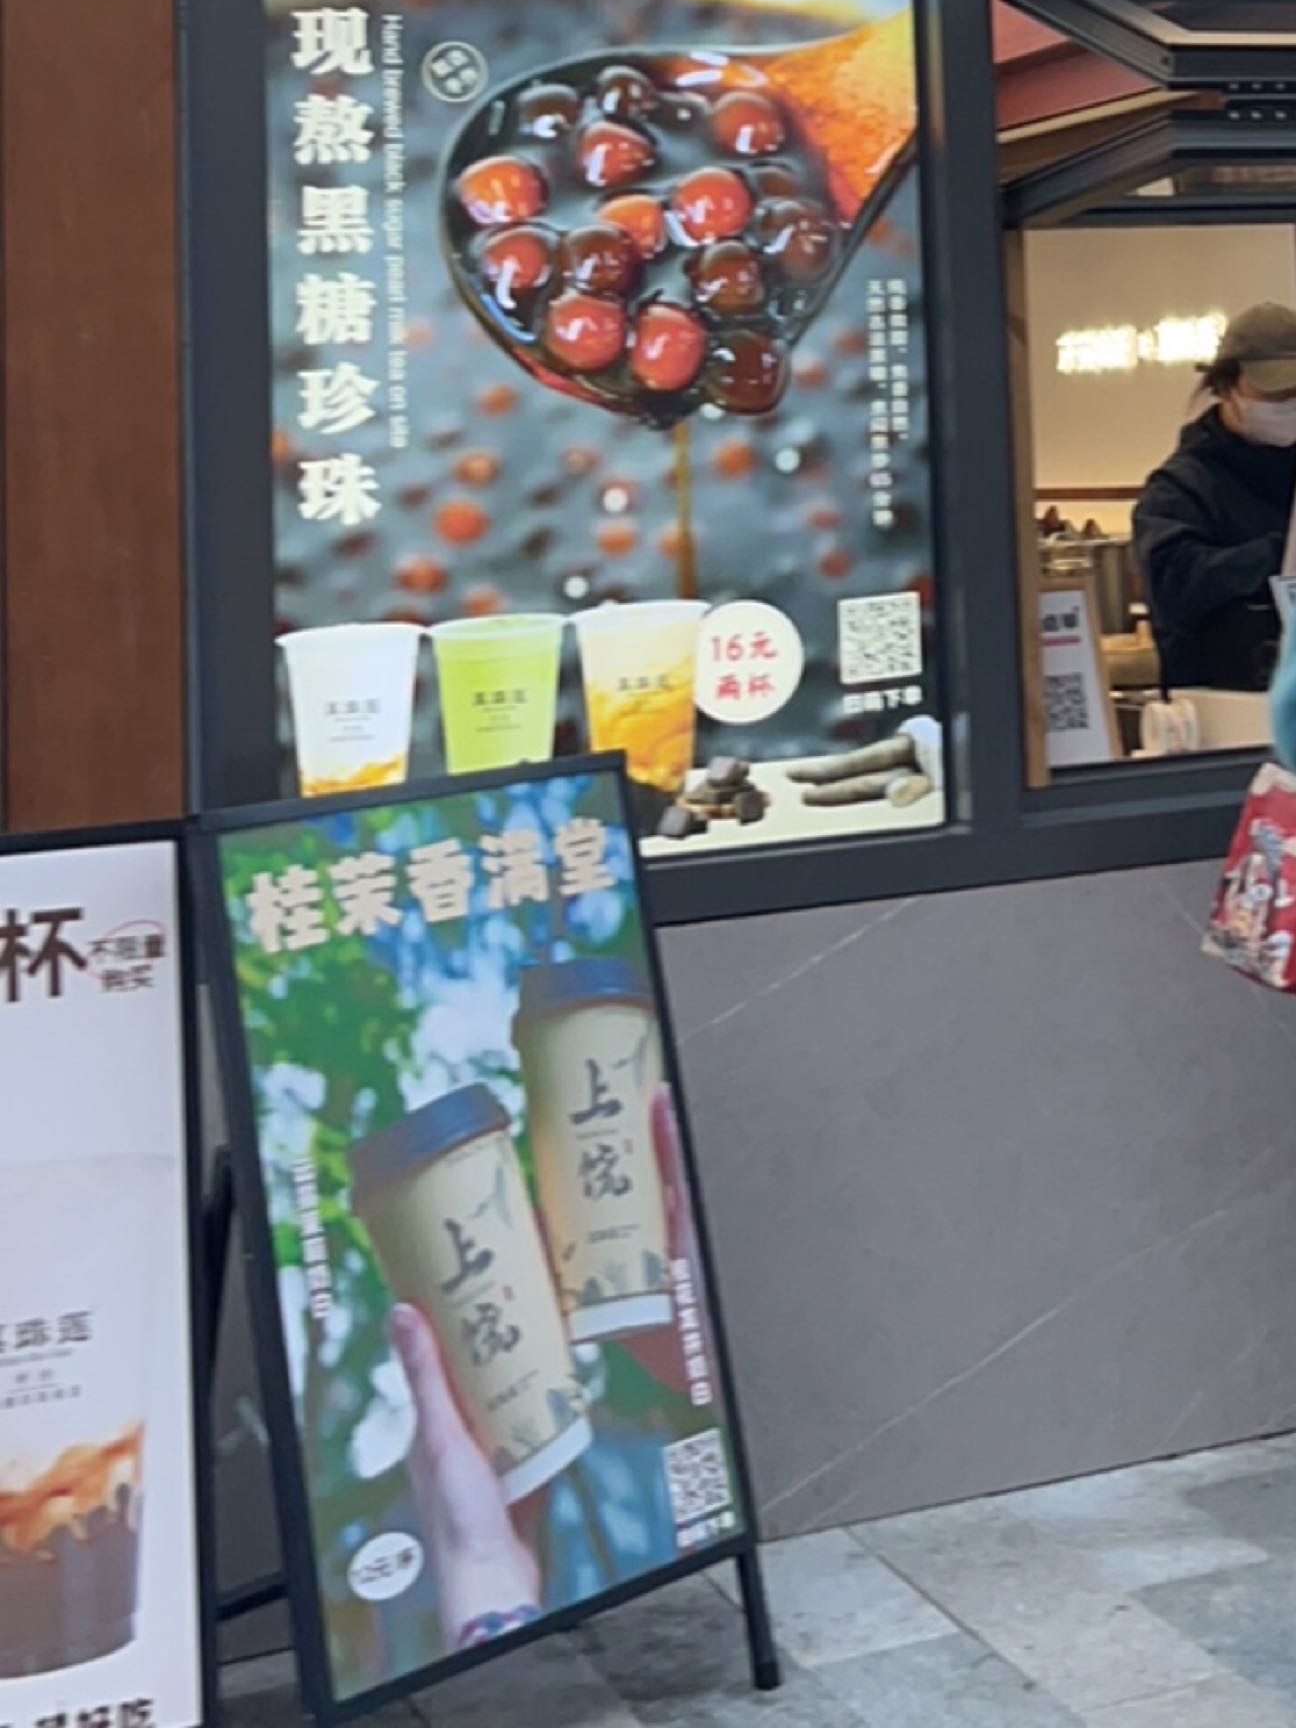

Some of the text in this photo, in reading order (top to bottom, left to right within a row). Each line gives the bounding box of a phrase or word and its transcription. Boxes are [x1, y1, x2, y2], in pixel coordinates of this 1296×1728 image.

[382, 14, 403, 64] Hand
[382, 69, 404, 138] brewed
[383, 143, 404, 193] black
[291, 8, 382, 526] 现熬黑糖珍珠
[711, 632, 778, 662] 16元
[715, 673, 776, 700] 两杯
[0, 907, 88, 1003] 杯
[0, 1309, 93, 1353] 珠莲
